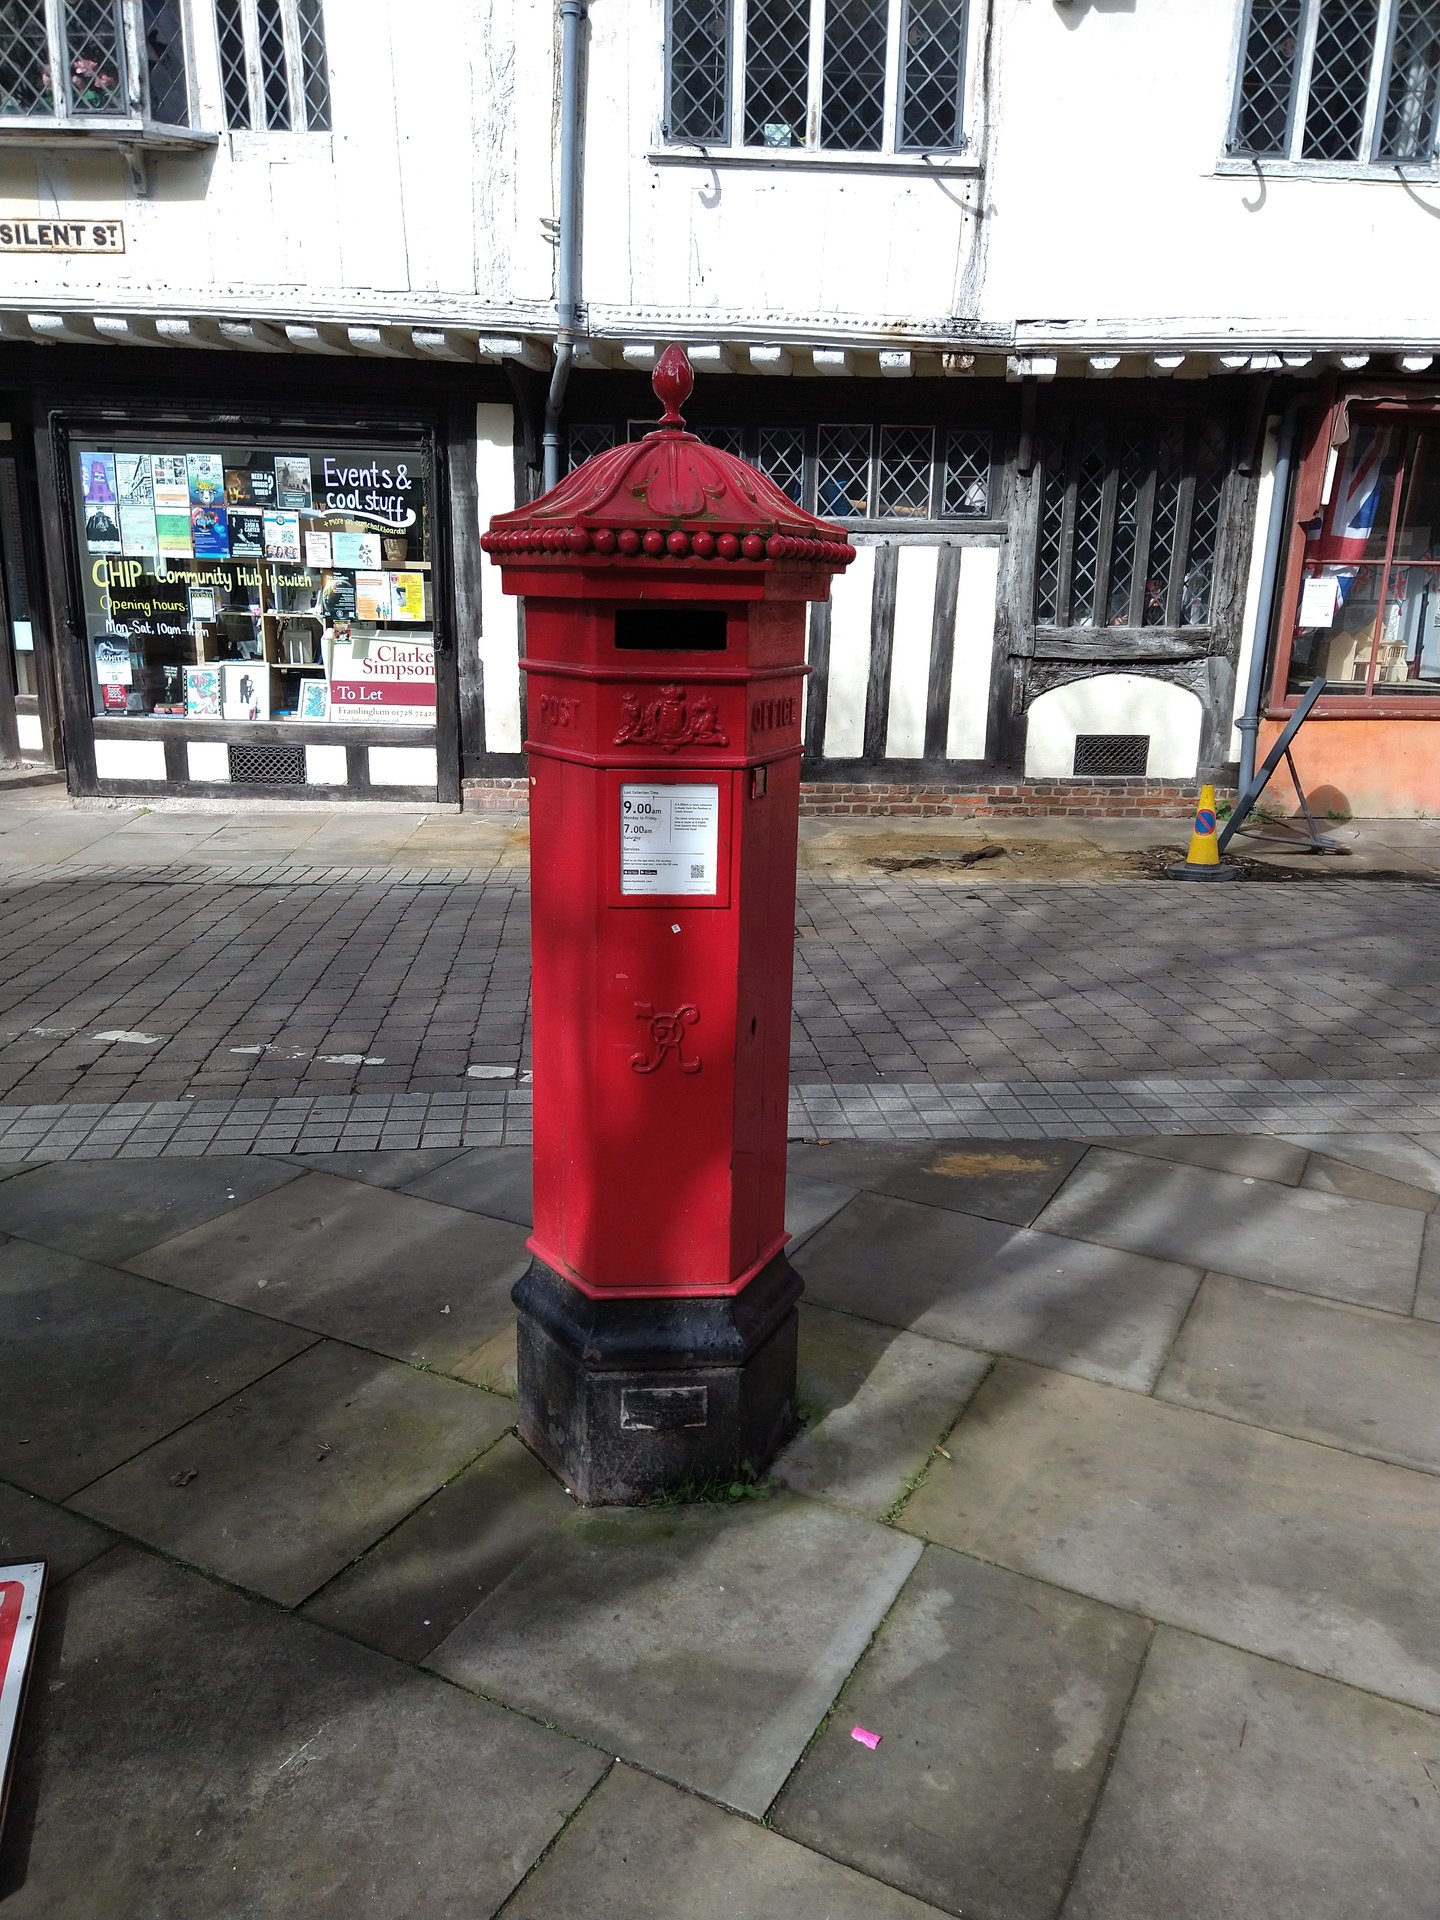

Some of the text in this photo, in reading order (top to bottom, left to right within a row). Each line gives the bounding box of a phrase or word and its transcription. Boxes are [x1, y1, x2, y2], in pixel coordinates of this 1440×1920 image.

[0, 224, 86, 246] SILENT
[324, 458, 412, 490] Events &
[326, 490, 362, 510] cool
[364, 490, 404, 522] stuff
[92, 560, 142, 588] CHIP
[155, 565, 232, 592] Community
[236, 566, 262, 586] Hub
[266, 568, 312, 594] Ipswich
[100, 594, 188, 618] Opening hours:
[106, 619, 210, 638] Mon-Sat, 10am-4pm
[377, 646, 434, 663] Clarke
[362, 658, 435, 680] Simpson
[337, 686, 383, 700] To Let
[338, 706, 390, 717] Framlingham
[391, 710, 413, 718] 01728
[540, 694, 798, 733] POST OFFICE
